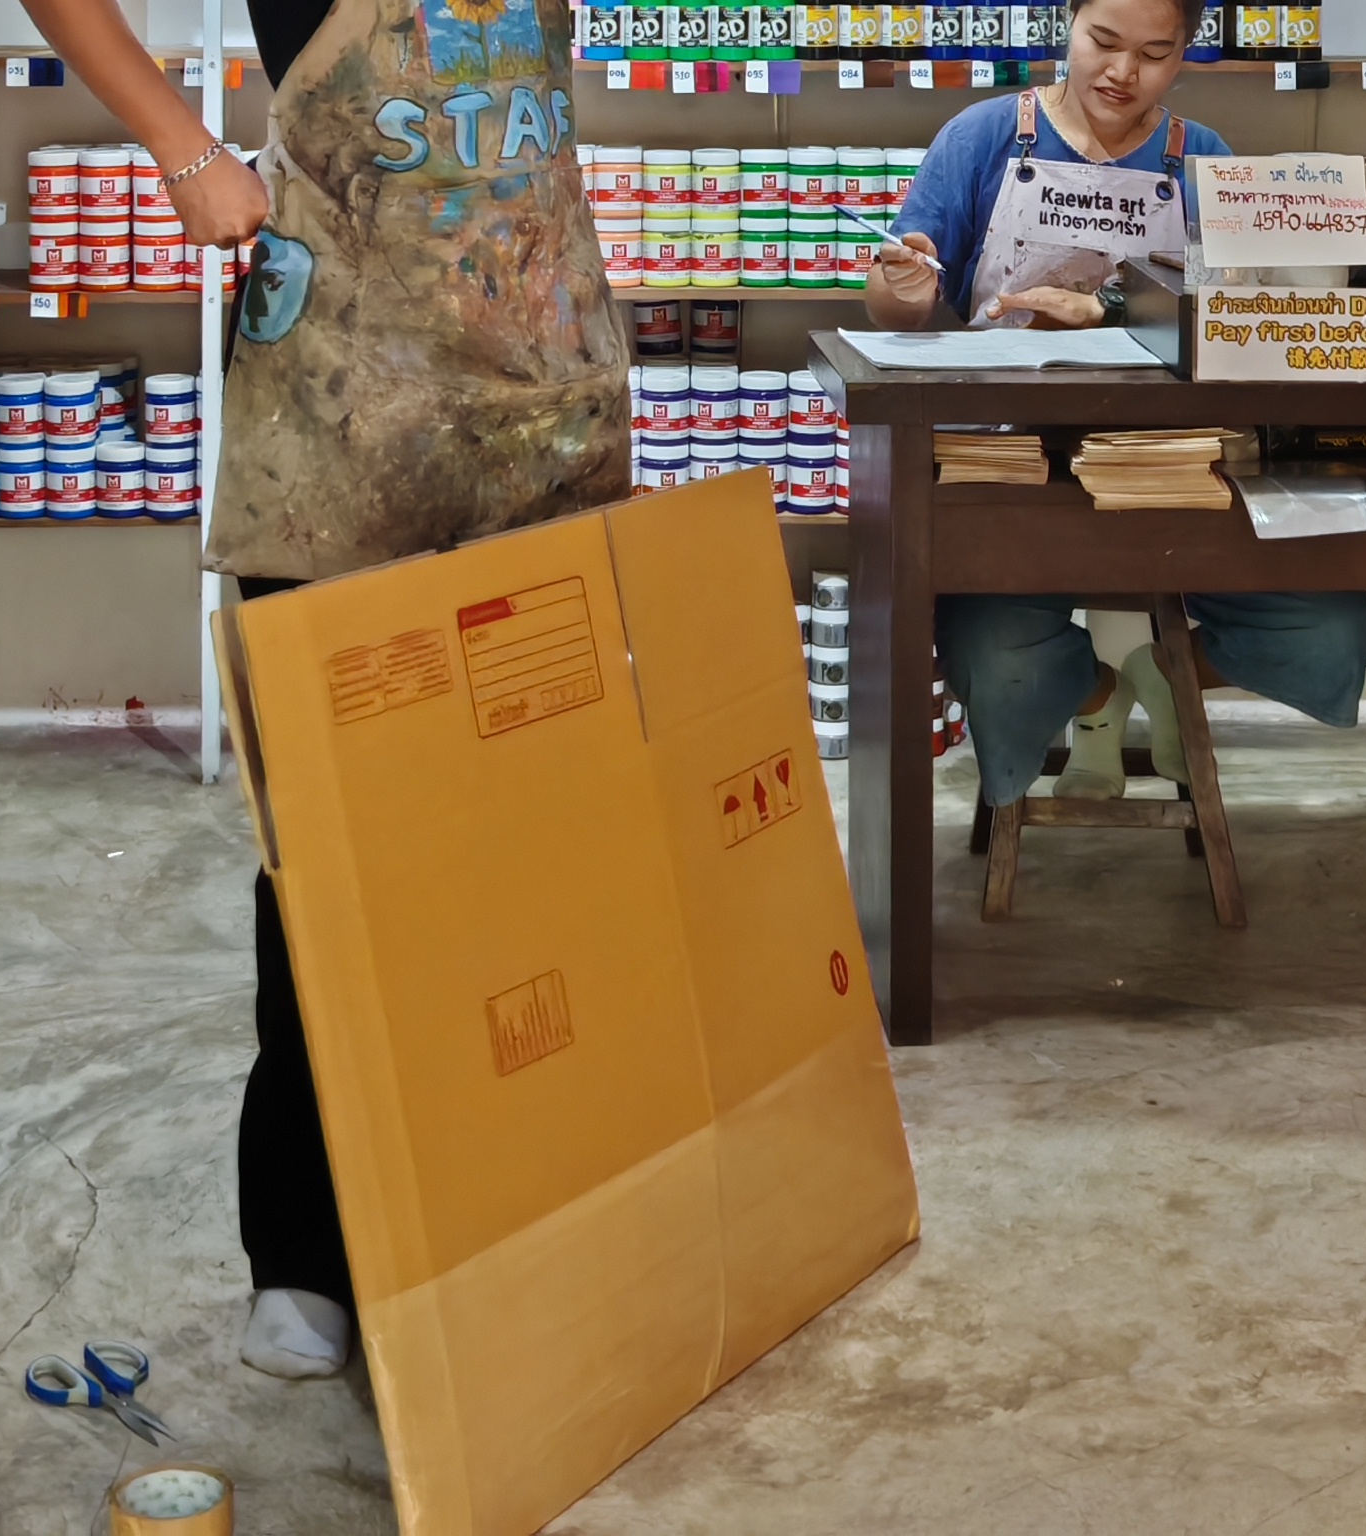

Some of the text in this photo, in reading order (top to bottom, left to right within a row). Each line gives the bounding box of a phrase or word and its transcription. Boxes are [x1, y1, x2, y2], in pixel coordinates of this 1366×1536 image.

[1041, 186, 1146, 217] Kaewta art
[1205, 321, 1252, 346] Pay
[1256, 321, 1315, 342] first
